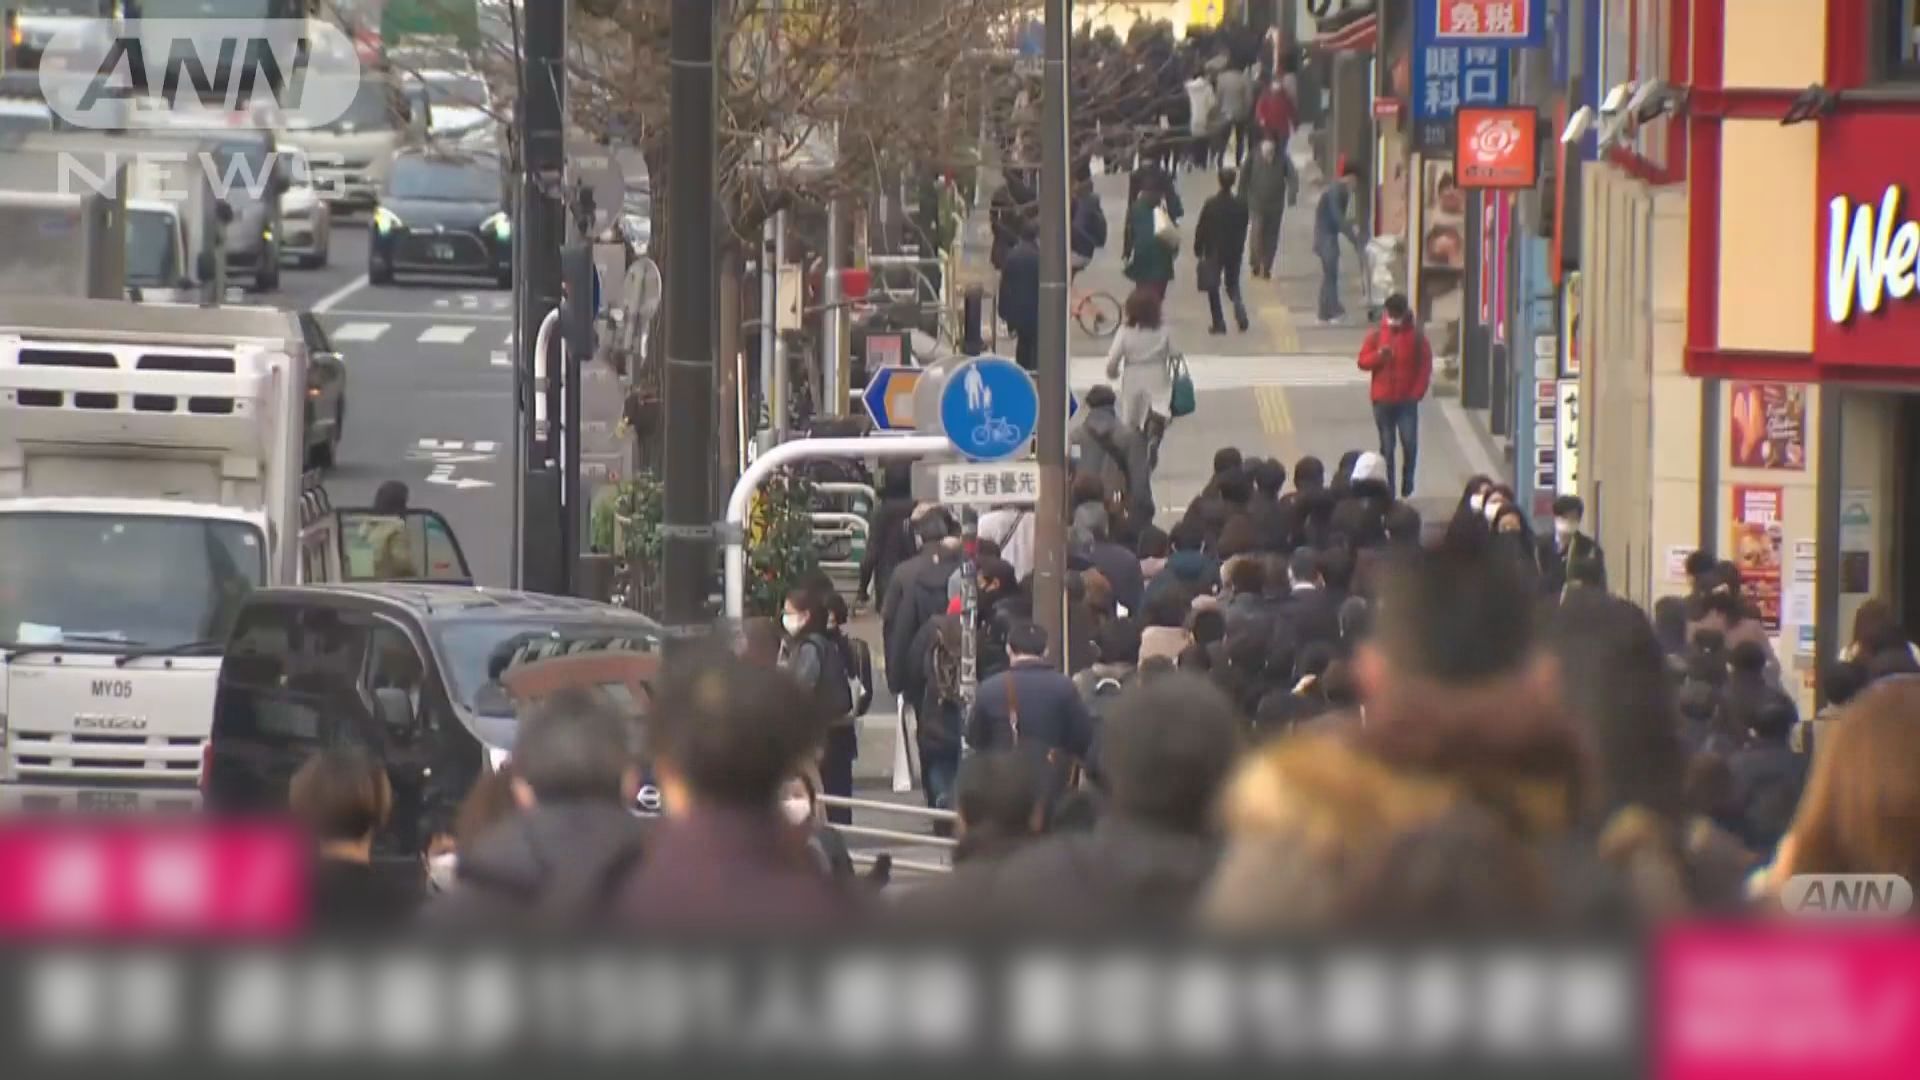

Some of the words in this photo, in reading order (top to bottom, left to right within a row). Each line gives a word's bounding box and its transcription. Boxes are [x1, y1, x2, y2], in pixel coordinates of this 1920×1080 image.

[1450, 1, 1514, 33] 免税
[1829, 183, 1920, 323] We
[943, 471, 1036, 496] 歩行者優先
[91, 680, 133, 698] MY05
